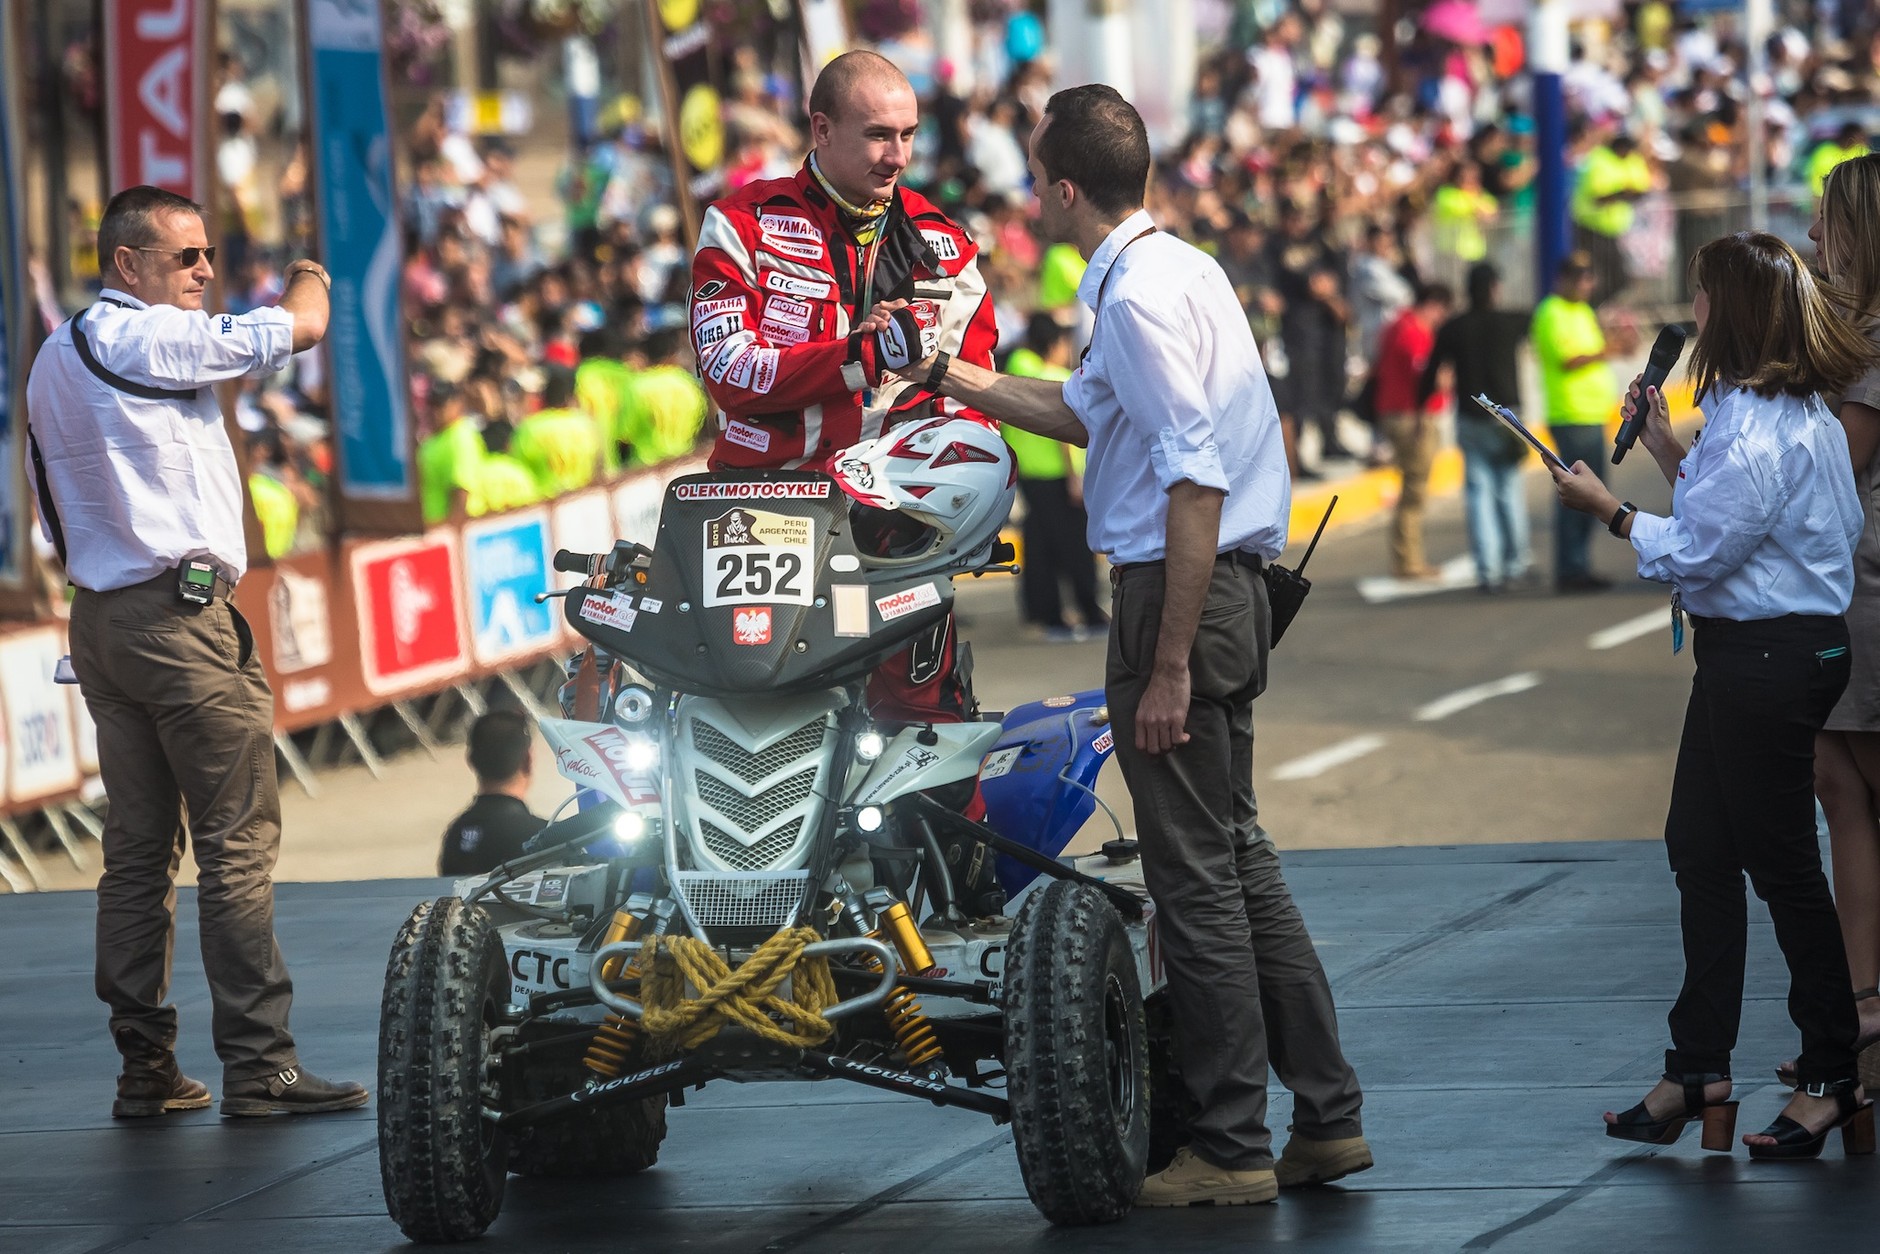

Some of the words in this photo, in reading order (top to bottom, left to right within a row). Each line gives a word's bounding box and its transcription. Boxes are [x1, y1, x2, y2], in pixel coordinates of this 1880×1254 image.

[770, 276, 793, 290] CTC
[697, 298, 743, 317] YAMAHA
[770, 300, 807, 316] MOTUL
[221, 316, 232, 335] TEC
[762, 323, 807, 340] motorrad
[697, 325, 724, 350] NIKA
[713, 357, 729, 380] CTC
[730, 425, 768, 443] motorrad
[678, 485, 721, 498] OLEK
[724, 483, 828, 498] MOTOCYKLE
[724, 533, 749, 545] DAKAR
[759, 528, 807, 536] ARGENTINA
[784, 536, 807, 544] CHILE
[716, 553, 801, 599] 252
[879, 586, 933, 612] motorrad
[584, 598, 637, 622] motorrad
[890, 605, 912, 616] YAMAHA
[588, 733, 657, 800] MOTUL
[512, 950, 570, 989] CTC
[589, 1060, 682, 1095] HOUSER
[845, 1062, 945, 1092] HOUSER
